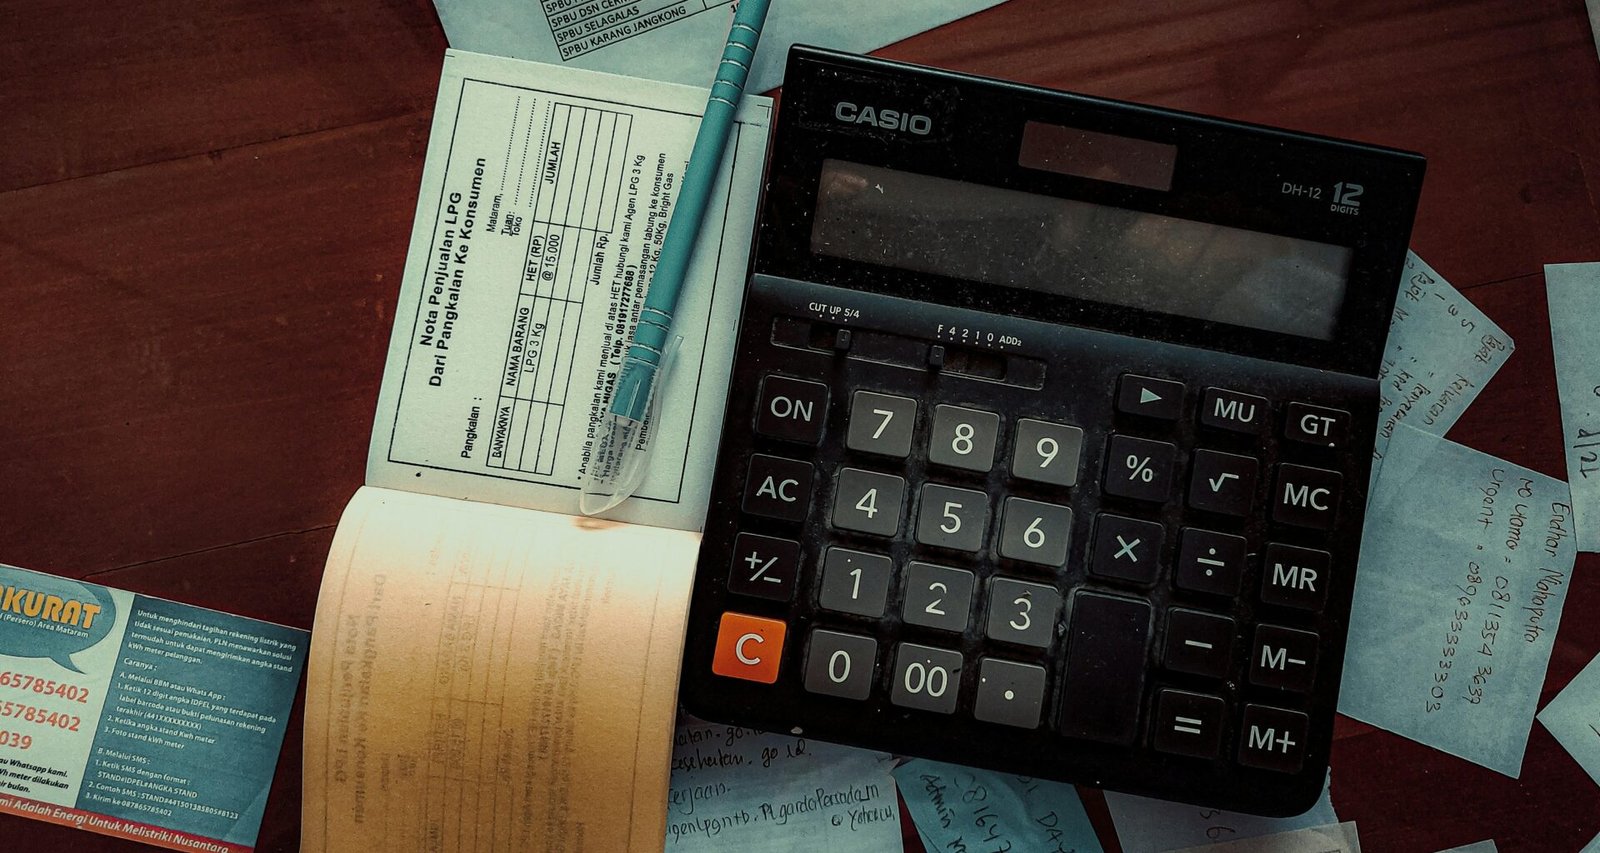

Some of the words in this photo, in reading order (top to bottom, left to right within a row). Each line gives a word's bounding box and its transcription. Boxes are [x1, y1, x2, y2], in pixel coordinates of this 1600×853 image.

[545, 0, 572, 12] SPBU
[551, 11, 578, 27] SPBU
[578, 3, 599, 17] DSN
[556, 25, 583, 42] SPBU
[583, 5, 639, 32] SELAGALAS
[561, 40, 588, 57] SPBU
[589, 24, 631, 47] KARANG
[631, 5, 686, 32] JANGKONG
[834, 100, 932, 135] CASIO
[544, 141, 562, 184] JUMLAH
[634, 153, 646, 167] Kg
[628, 176, 641, 195] LPG
[650, 152, 667, 197] konsumen
[662, 172, 675, 192] Gas
[459, 156, 486, 240] Konsumen
[648, 197, 659, 208] ke
[1280, 181, 1322, 200] DH-12
[1332, 180, 1364, 207] 12
[624, 196, 639, 221] Agen
[657, 193, 673, 219] Bright
[1329, 203, 1359, 217] DIGITS
[511, 216, 522, 237] Toko
[619, 221, 632, 243] kami
[642, 209, 658, 241] tabung
[453, 243, 469, 264] Ke
[529, 234, 545, 258] (RP)
[544, 233, 561, 268] 15.000
[596, 232, 610, 249] Rp.
[420, 309, 438, 346] Nota
[429, 228, 456, 306] Penjualan
[445, 191, 462, 224] LPG
[525, 260, 539, 281] HET
[589, 250, 604, 285] Jumlah
[612, 244, 630, 281] hubungi
[632, 242, 653, 298] pemasangan
[648, 262, 658, 274] 12
[609, 281, 621, 300] HET
[436, 268, 466, 351] Pangkalan
[606, 302, 618, 320] atas
[627, 298, 640, 323] antar
[809, 302, 827, 313] CUT
[829, 305, 842, 315] UP
[844, 308, 859, 319] 5/4
[512, 306, 530, 353] BARANG
[532, 322, 545, 338] Kg
[603, 321, 614, 331] di
[937, 325, 944, 333] F
[950, 327, 956, 335] 4
[962, 329, 969, 337] 2
[976, 331, 980, 339] 1
[987, 333, 994, 341] 0
[529, 338, 540, 347] 3
[597, 332, 614, 368] menjual
[610, 335, 624, 359] Telp.
[428, 354, 446, 387] Dari
[506, 353, 521, 386] NAMA
[524, 348, 538, 373] LPG
[592, 369, 606, 391] kami
[584, 393, 603, 439] pangkalan
[770, 396, 813, 421] ON
[1213, 397, 1255, 423] MU
[460, 405, 482, 459] Pangkalan
[492, 405, 510, 458] BANYAKNYA
[872, 408, 894, 439] 7
[1300, 414, 1335, 437] GT
[951, 422, 975, 455] 8
[1036, 437, 1059, 468] 9
[1126, 455, 1153, 482] %
[756, 475, 799, 502] AC
[1283, 483, 1331, 512] MC
[856, 488, 878, 519] 4
[939, 502, 963, 534] 5
[1023, 517, 1046, 548] 6
[849, 568, 863, 600] 1
[1272, 563, 1318, 592] MR
[925, 582, 946, 616] 2
[3, 613, 36, 627] (Persero)
[37, 621, 54, 631] Area
[55, 624, 89, 638] Mataram
[1009, 597, 1032, 631] 3
[134, 620, 152, 630] tidak
[152, 624, 173, 634] sesuai
[213, 637, 228, 646] PLN
[227, 640, 271, 657] menawarkan
[271, 650, 292, 661] solusi
[137, 609, 158, 620] Untuk
[158, 614, 201, 631] menghindari
[201, 624, 228, 637] tagihan
[228, 630, 258, 643] rekening
[258, 636, 278, 647] listrik
[278, 642, 296, 652] yang
[127, 641, 144, 651] kWh
[144, 645, 165, 656] meter
[131, 631, 164, 645] termudah
[164, 638, 184, 649] untuk
[184, 643, 205, 654] dapat
[205, 647, 251, 664] mengirimkan
[251, 657, 273, 669] angka
[272, 662, 293, 673] stand
[735, 633, 765, 665] C
[123, 657, 153, 671] Caranya
[828, 650, 851, 684] 0
[0, 671, 90, 704] 65785402
[904, 662, 948, 697] 00
[1248, 725, 1295, 753] M+
[8, 770, 31, 781] meter
[31, 774, 69, 789] dilakukan
[9, 759, 47, 774] Whatsapp
[101, 760, 120, 770] Ketik
[120, 764, 136, 774] SMS
[136, 767, 162, 781] dengan
[163, 773, 187, 785] format
[6, 781, 31, 793] bulan.
[93, 792, 112, 803] Kirim
[13, 799, 52, 816] Adalah
[51, 807, 88, 827] Energi
[88, 814, 121, 832] Untuk
[121, 822, 172, 843] Melistriki
[172, 833, 229, 853] Nusantara
